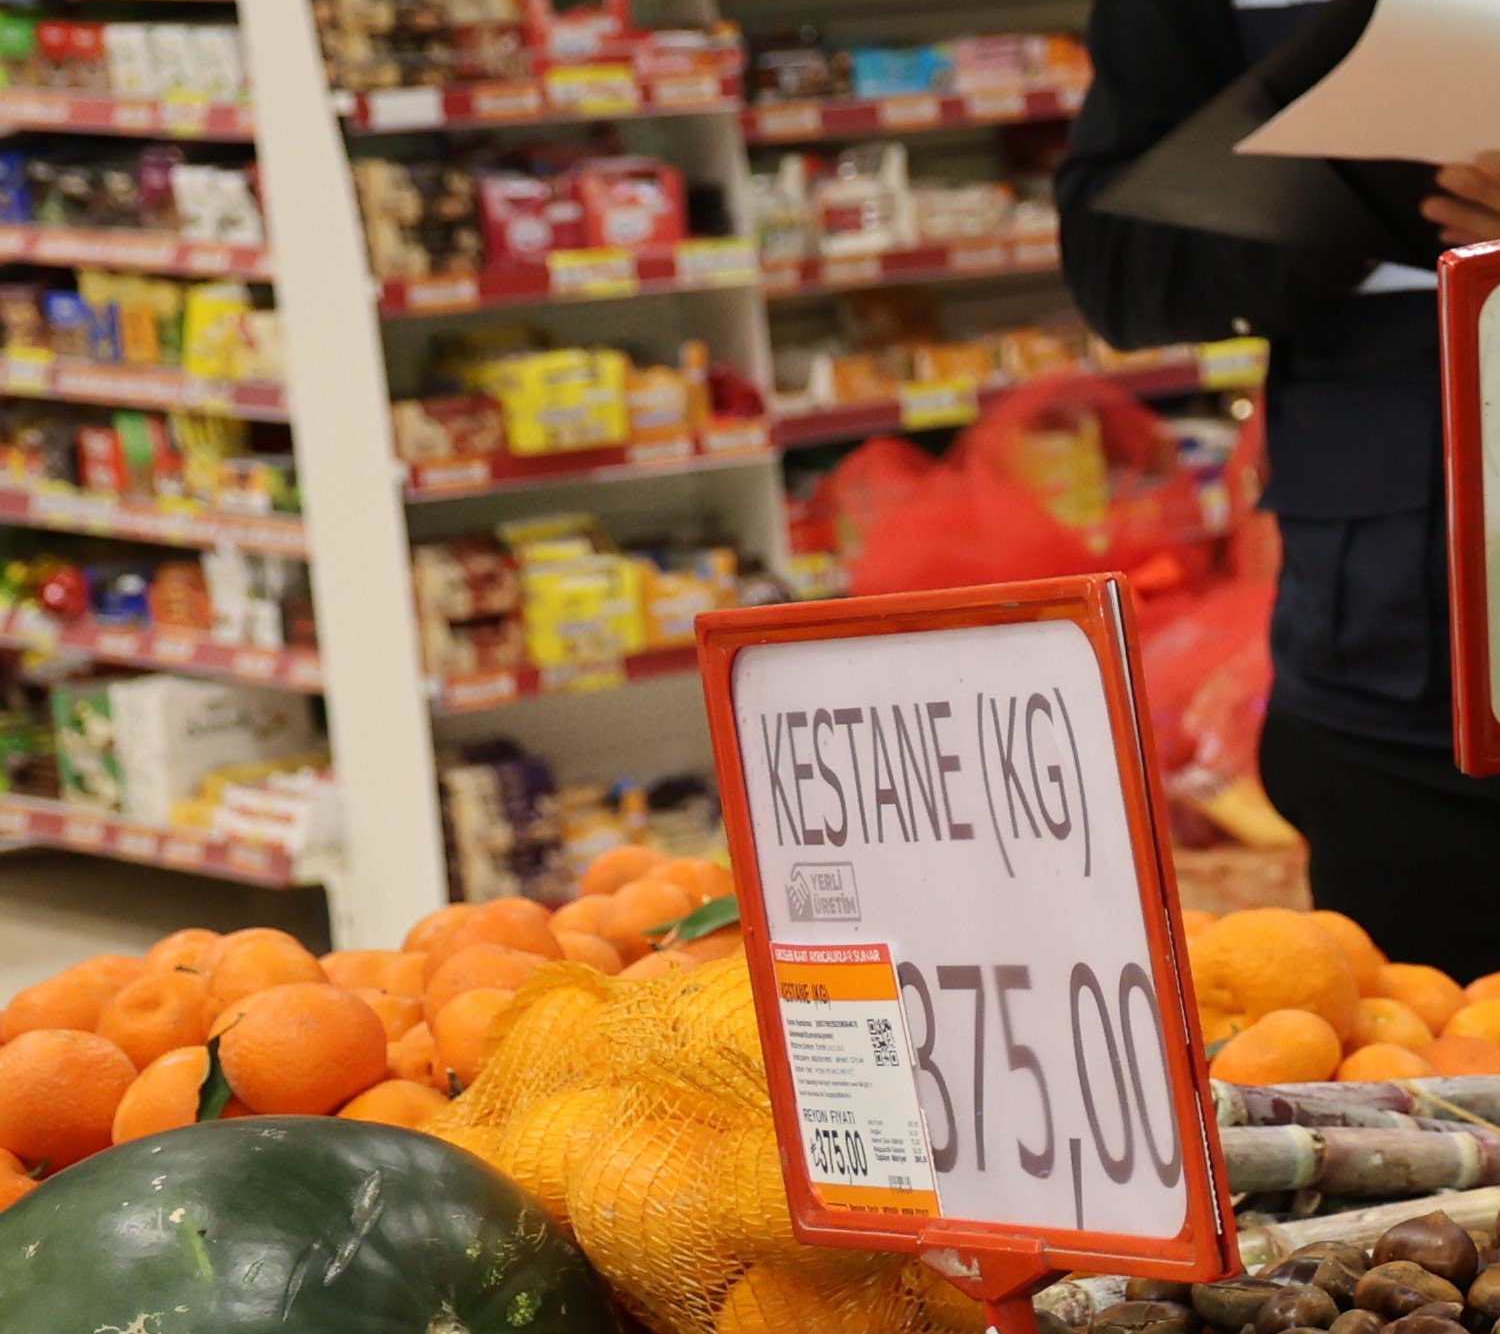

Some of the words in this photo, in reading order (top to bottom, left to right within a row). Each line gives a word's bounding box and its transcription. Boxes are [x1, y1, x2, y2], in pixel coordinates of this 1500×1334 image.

[762, 702, 975, 848] KESTANE
[976, 687, 1092, 879] (KG)
[810, 869, 843, 891] YERLİ
[813, 893, 857, 915] ÜRETİM
[802, 1108, 829, 1124] REYON
